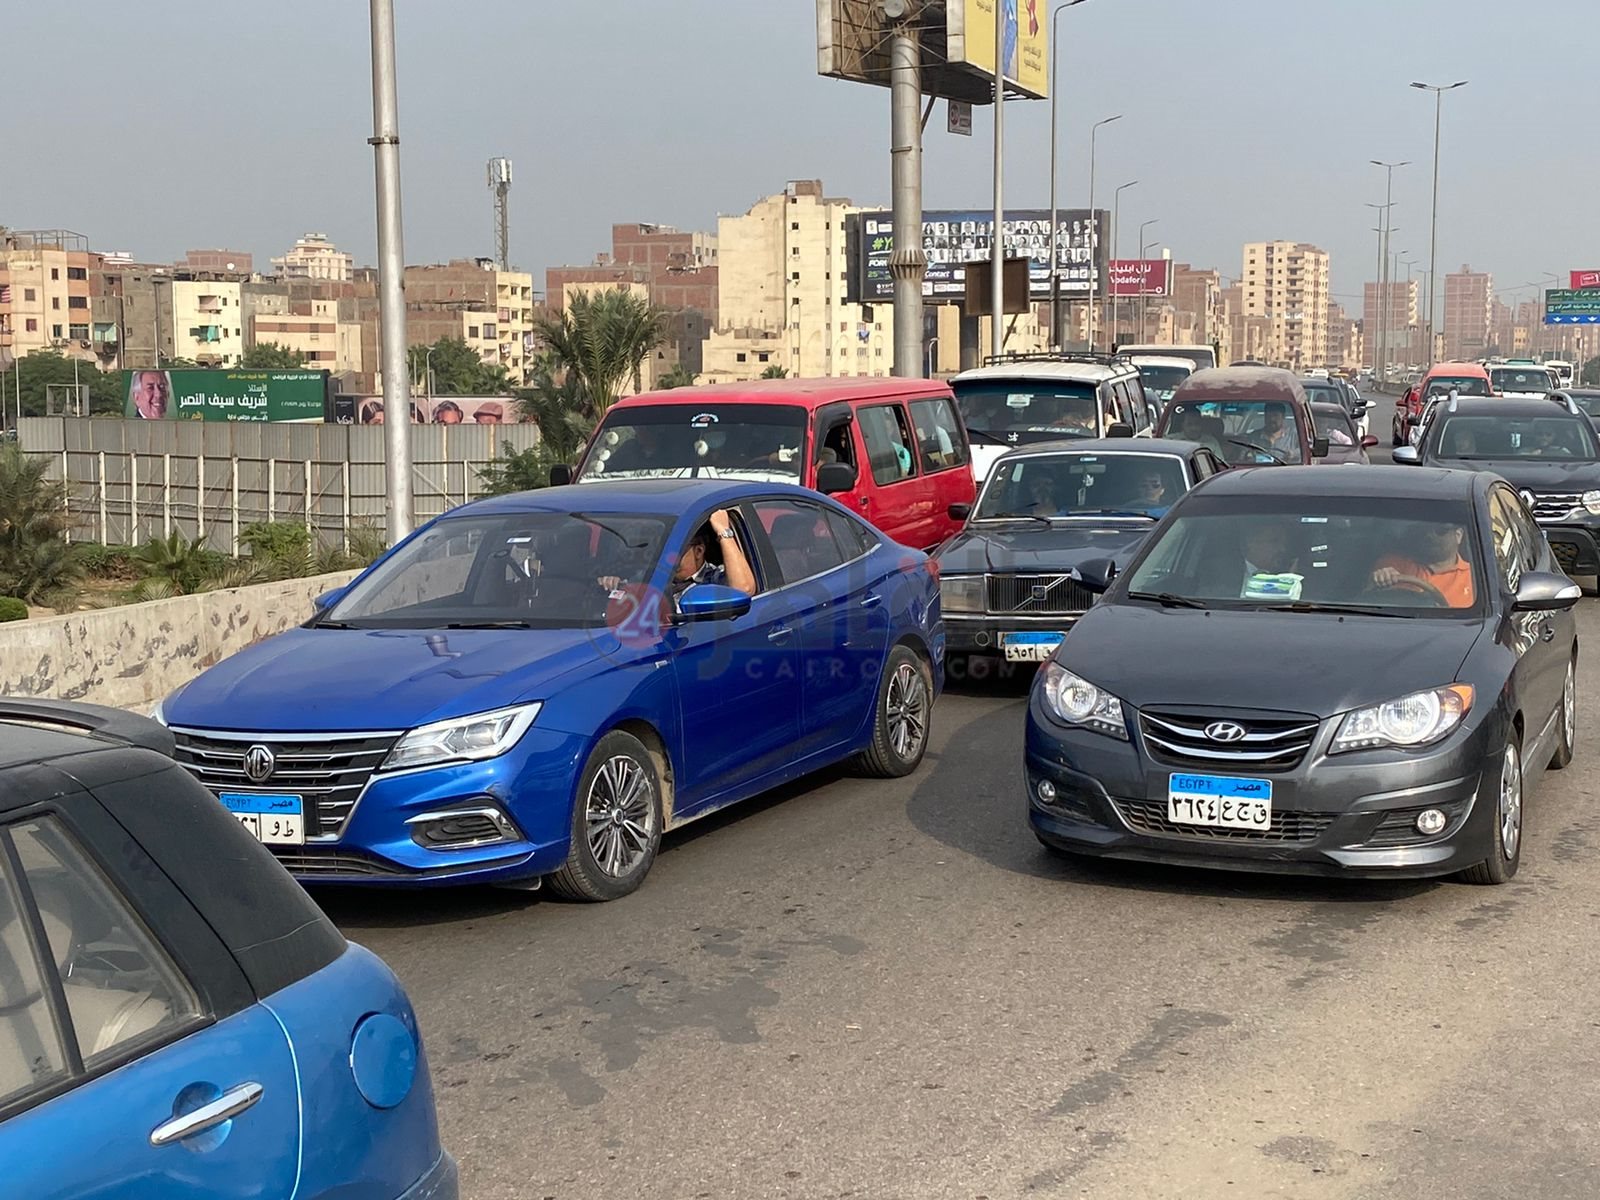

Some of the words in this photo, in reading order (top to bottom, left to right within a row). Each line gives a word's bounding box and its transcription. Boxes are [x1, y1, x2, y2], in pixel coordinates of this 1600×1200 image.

[924, 270, 950, 278] Contact
[179, 392, 205, 409] النصر
[208, 393, 235, 409] سيف
[237, 392, 268, 409] شريف
[1179, 778, 1212, 790] EGYPT
[1232, 783, 1262, 792] مصر
[226, 798, 252, 809] EGYPT
[268, 800, 293, 809] مصر
